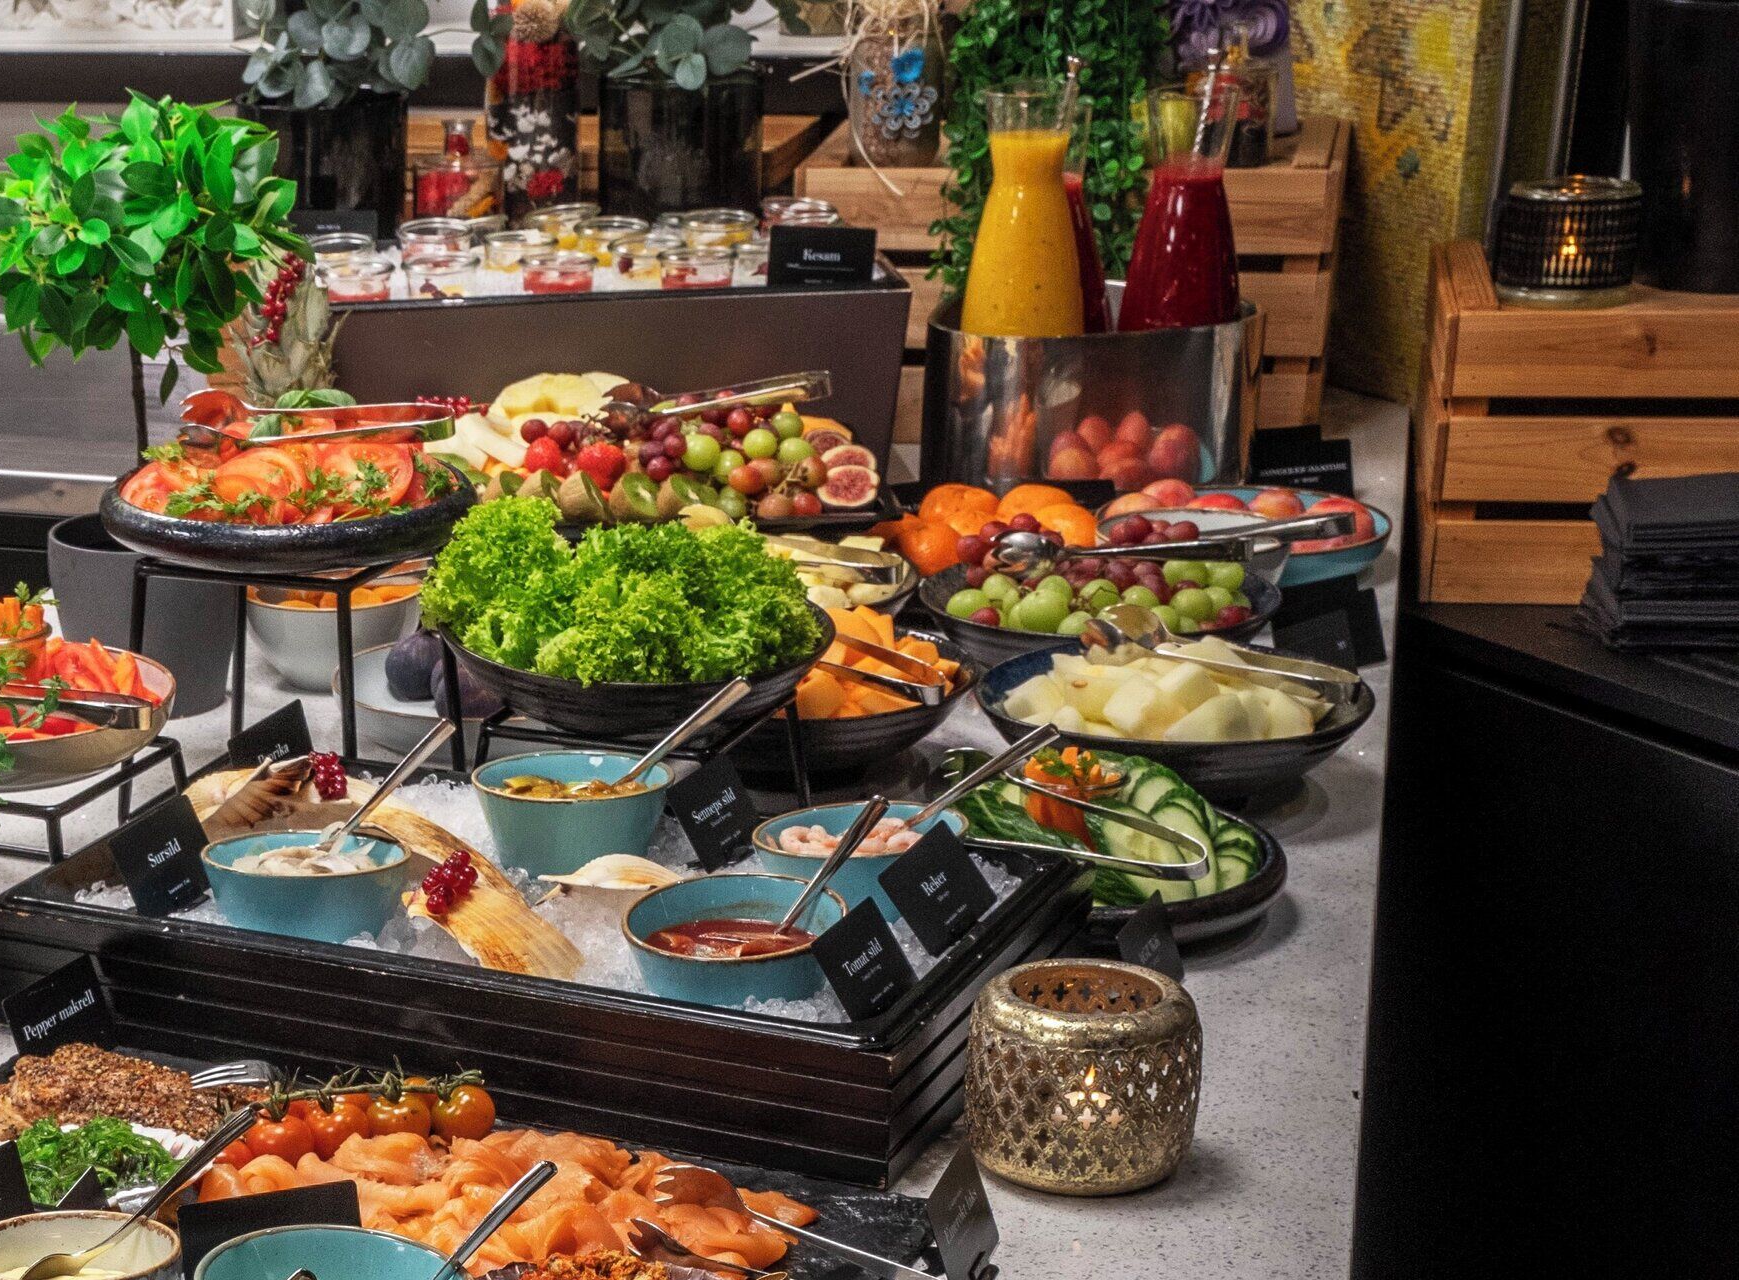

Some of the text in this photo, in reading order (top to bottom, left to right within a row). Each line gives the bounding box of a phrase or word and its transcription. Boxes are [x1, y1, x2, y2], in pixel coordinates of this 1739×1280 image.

[147, 837, 182, 868] Sursild
[841, 952, 870, 978] Tomat
[22, 988, 95, 1041] Pepper makrell
